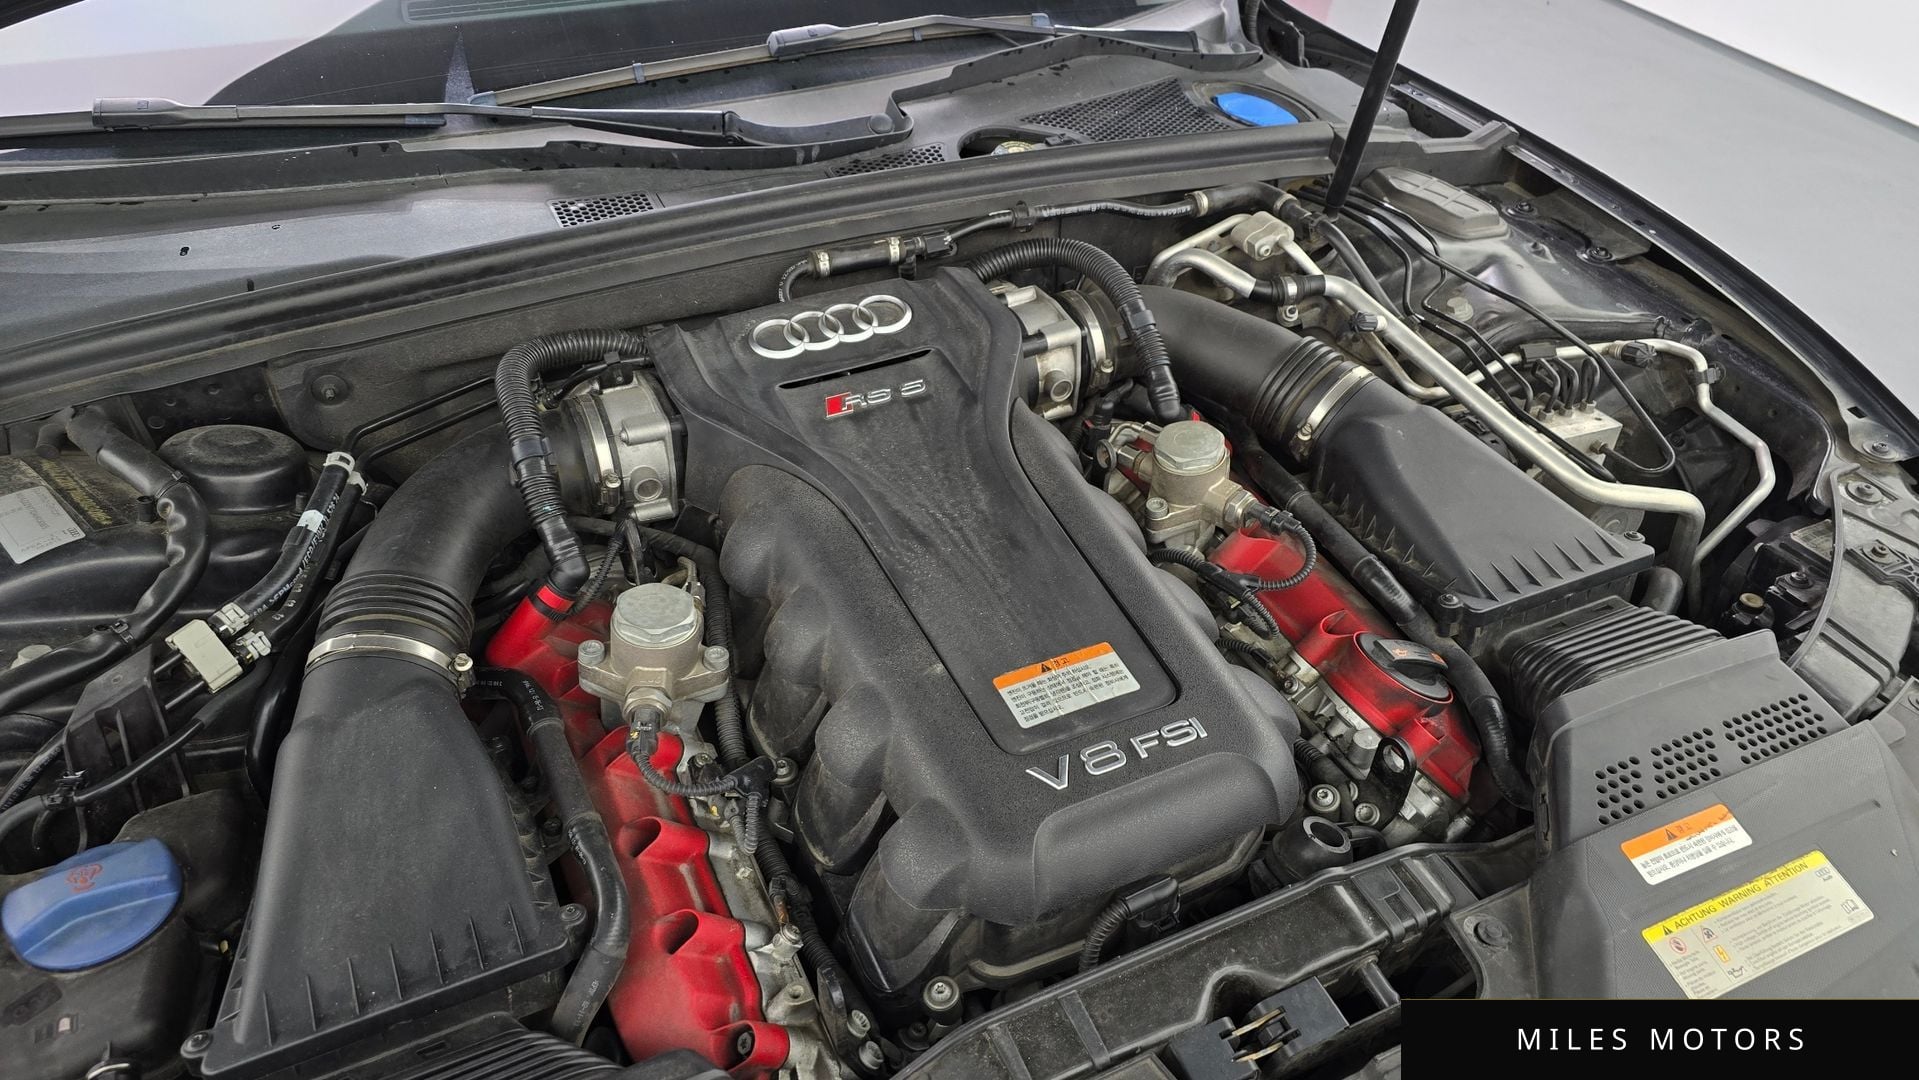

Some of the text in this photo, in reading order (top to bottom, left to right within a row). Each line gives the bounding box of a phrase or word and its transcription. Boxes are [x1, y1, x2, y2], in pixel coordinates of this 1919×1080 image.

[842, 379, 926, 411] RS 5
[1130, 716, 1208, 759] FSI
[1674, 905, 1716, 929] ACHTUNG
[1719, 884, 1761, 908] WARNING
[1764, 862, 1808, 887] ATTENTION
